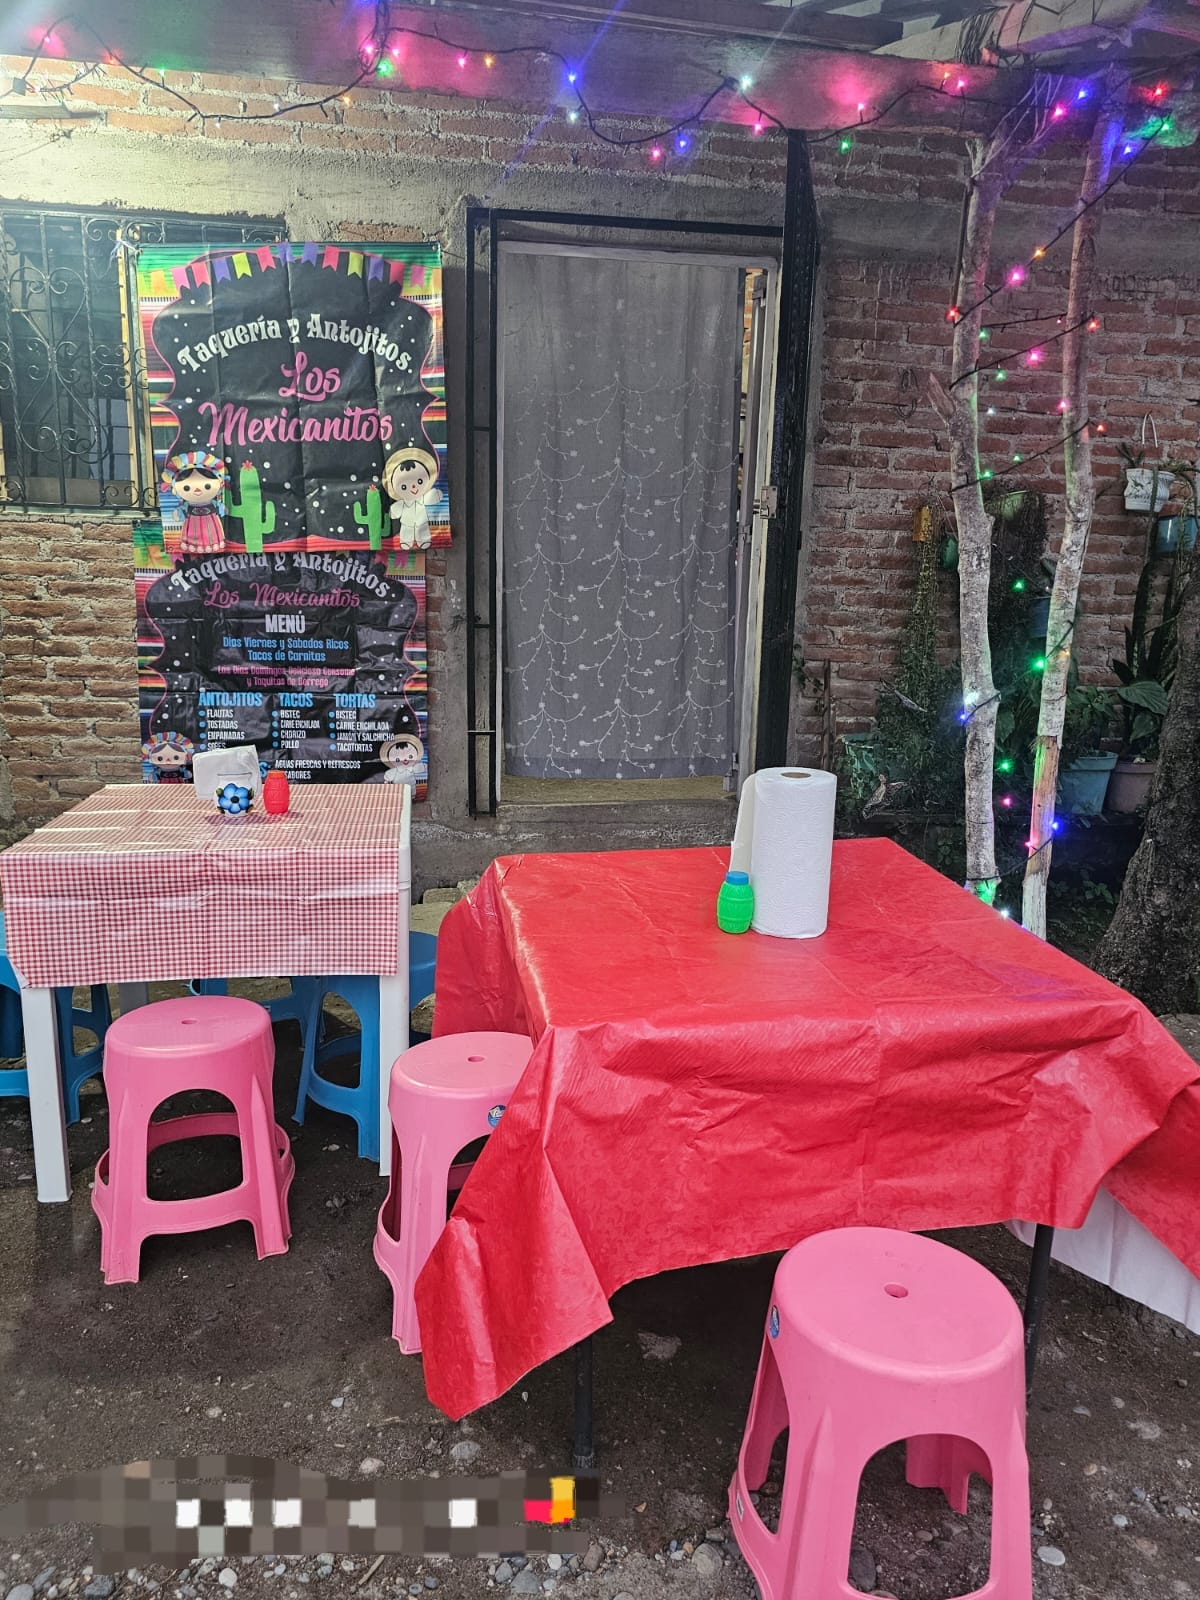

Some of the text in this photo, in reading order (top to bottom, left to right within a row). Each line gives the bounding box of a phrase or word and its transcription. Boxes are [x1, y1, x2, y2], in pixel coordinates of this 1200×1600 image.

[177, 314, 412, 372] Taquería y Antojitos
[278, 351, 342, 401] Los
[198, 401, 393, 446] Mexicanitos
[292, 552, 391, 598] Antojitos
[203, 581, 361, 608] Los Mexicanitos
[265, 610, 306, 634] MENÚ
[243, 636, 278, 649] Viernes
[279, 639, 285, 651] y
[326, 638, 350, 650] Ricos
[247, 649, 326, 662] Tacos de Carnitas
[198, 691, 263, 707] ANTOJITOS
[278, 692, 314, 707] TACOS
[333, 693, 376, 708] TORTAS
[206, 709, 234, 718] FLAUTAS
[280, 709, 301, 719] BISTEC
[335, 710, 357, 720] BISTEC
[207, 720, 239, 730] TOSTADAS
[335, 721, 390, 732] CARNE ENCHILADA
[207, 731, 246, 741] EMPANADAS
[280, 729, 307, 739] CHORIZO
[361, 732, 395, 742] SALCHICHA
[280, 740, 300, 749] POLLO
[274, 759, 361, 769] AGUAS FRESCAS Y REFRESCOS
